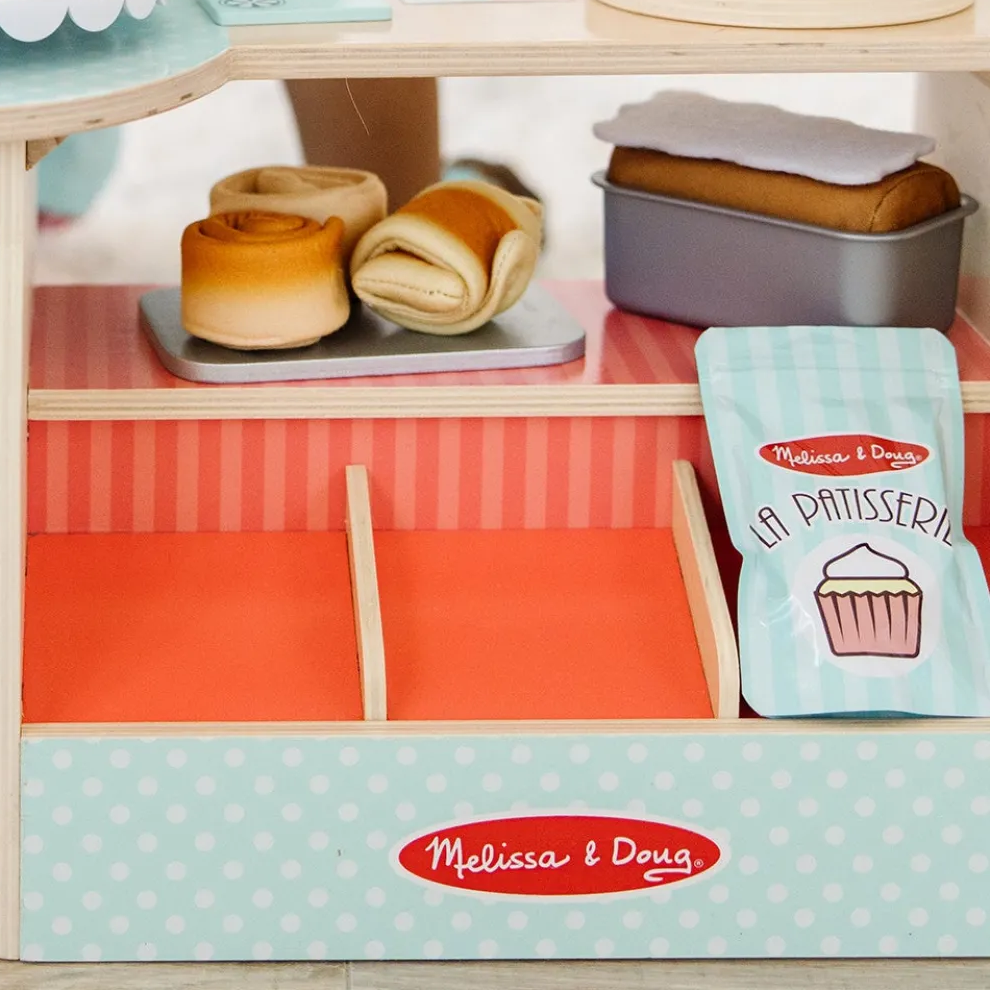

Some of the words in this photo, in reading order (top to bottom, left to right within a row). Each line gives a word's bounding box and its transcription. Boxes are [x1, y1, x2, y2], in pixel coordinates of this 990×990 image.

[772, 445, 850, 467] Melissa
[856, 446, 867, 460] &
[871, 444, 917, 468] Doug
[748, 506, 791, 549] LA
[424, 836, 571, 880] Melissa
[584, 840, 600, 867] &
[612, 836, 692, 882] Doug
